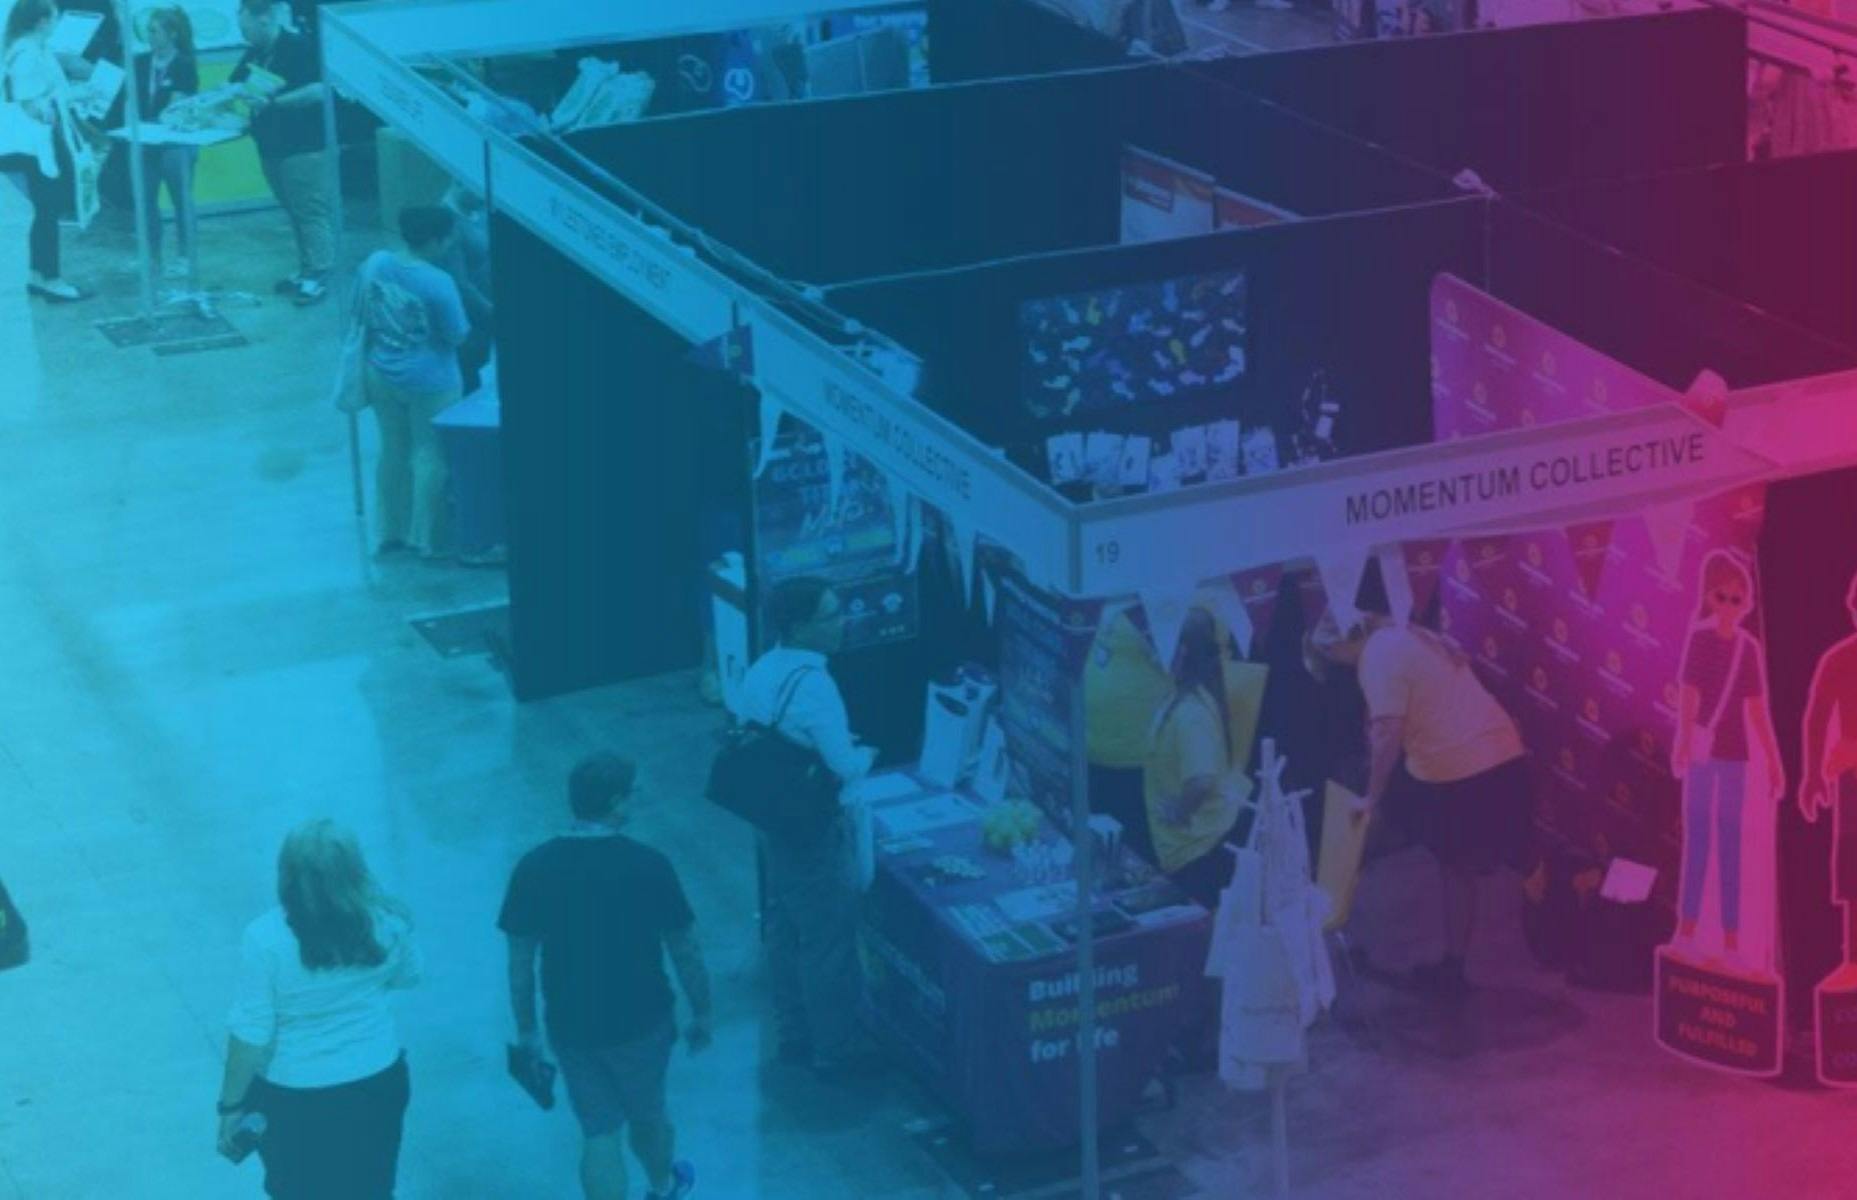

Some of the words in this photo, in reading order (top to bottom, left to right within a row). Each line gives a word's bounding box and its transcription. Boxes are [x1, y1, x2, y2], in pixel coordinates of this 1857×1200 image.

[1345, 465, 1522, 526] MOMENTUM
[1529, 432, 1706, 492] COLLECTIVE
[1096, 540, 1120, 564] 19
[1701, 1006, 1737, 1029] AND
[1030, 1039, 1072, 1064] for
